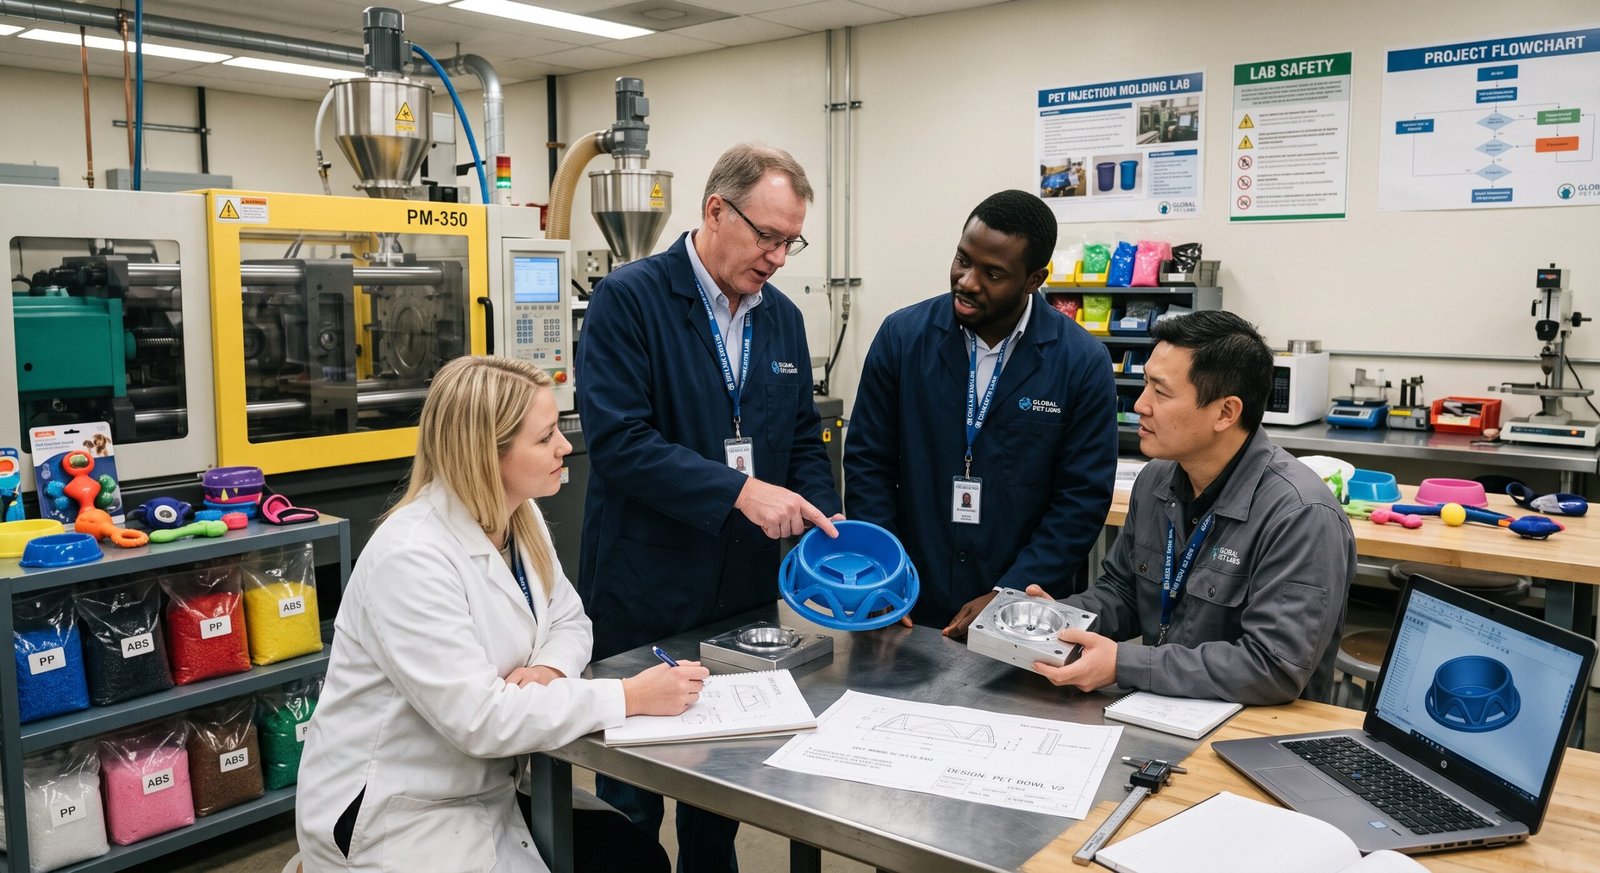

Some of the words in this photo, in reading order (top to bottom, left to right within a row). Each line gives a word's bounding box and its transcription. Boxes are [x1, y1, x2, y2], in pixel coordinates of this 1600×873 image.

[1424, 45, 1488, 64] PROJECT
[1491, 35, 1586, 58] FLOWCHART
[1250, 65, 1276, 80] LAB
[1280, 58, 1335, 77] SAFETY
[1048, 92, 1066, 104] PET
[1067, 86, 1117, 102] INJECTION
[1119, 80, 1167, 96] MOLDING
[1170, 78, 1190, 91] LAB
[407, 209, 468, 227] PM-350
[1032, 399, 1058, 408] GLOBAL
[283, 600, 302, 612] ABS
[209, 621, 223, 632] PP
[126, 639, 150, 651] ABS
[39, 654, 55, 666] PP
[224, 754, 245, 767] ABS
[146, 774, 170, 789] ABS
[992, 775, 1012, 784] PET
[1016, 778, 1045, 789] BOWL
[1051, 784, 1065, 792] V2
[59, 806, 76, 818] PP
